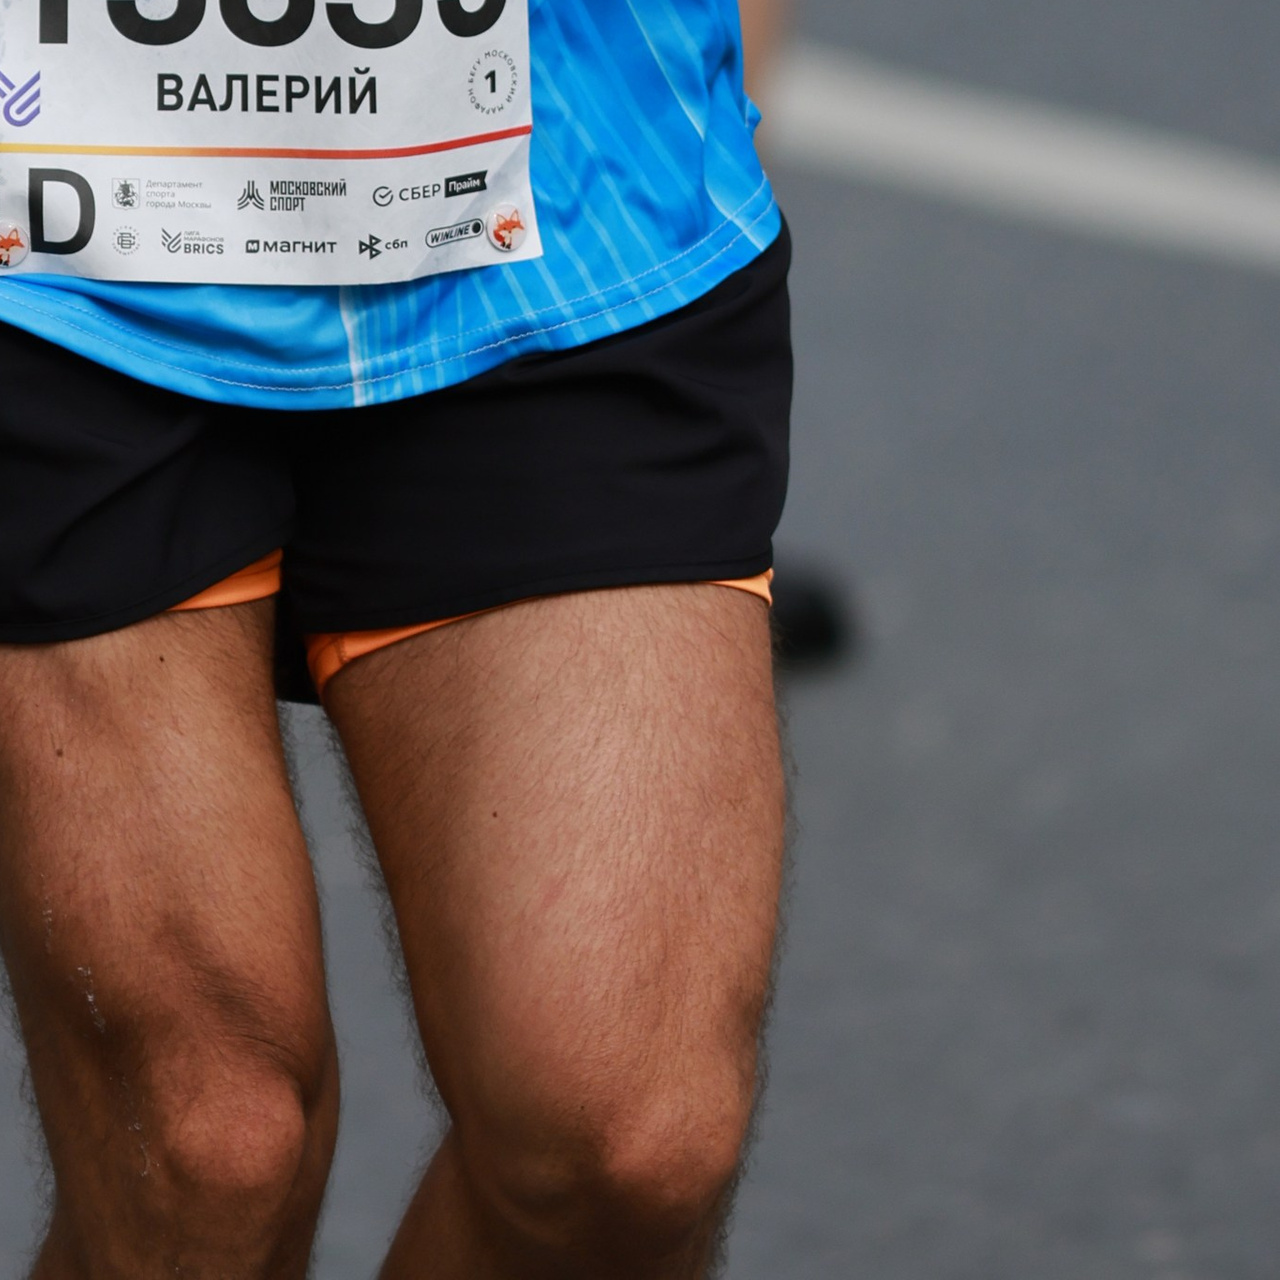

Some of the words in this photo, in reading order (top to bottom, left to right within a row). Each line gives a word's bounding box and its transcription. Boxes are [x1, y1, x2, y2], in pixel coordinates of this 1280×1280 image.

[484, 69, 496, 94] 1
[156, 67, 377, 115] ВАЛЕРИЙ
[145, 179, 203, 189] Департамент
[270, 178, 347, 196] МОСКОВСКИЙ
[398, 183, 441, 202] СБЕР
[448, 177, 481, 192] Прайм
[146, 190, 176, 199] спорта
[28, 167, 96, 256] D
[146, 201, 176, 209] города
[178, 200, 212, 209] Москвы
[270, 197, 306, 212] СПОРТ
[430, 224, 471, 244] WINLINE
[183, 243, 225, 255] BRICS
[263, 241, 337, 253] магнит
[385, 239, 409, 250] сбп
